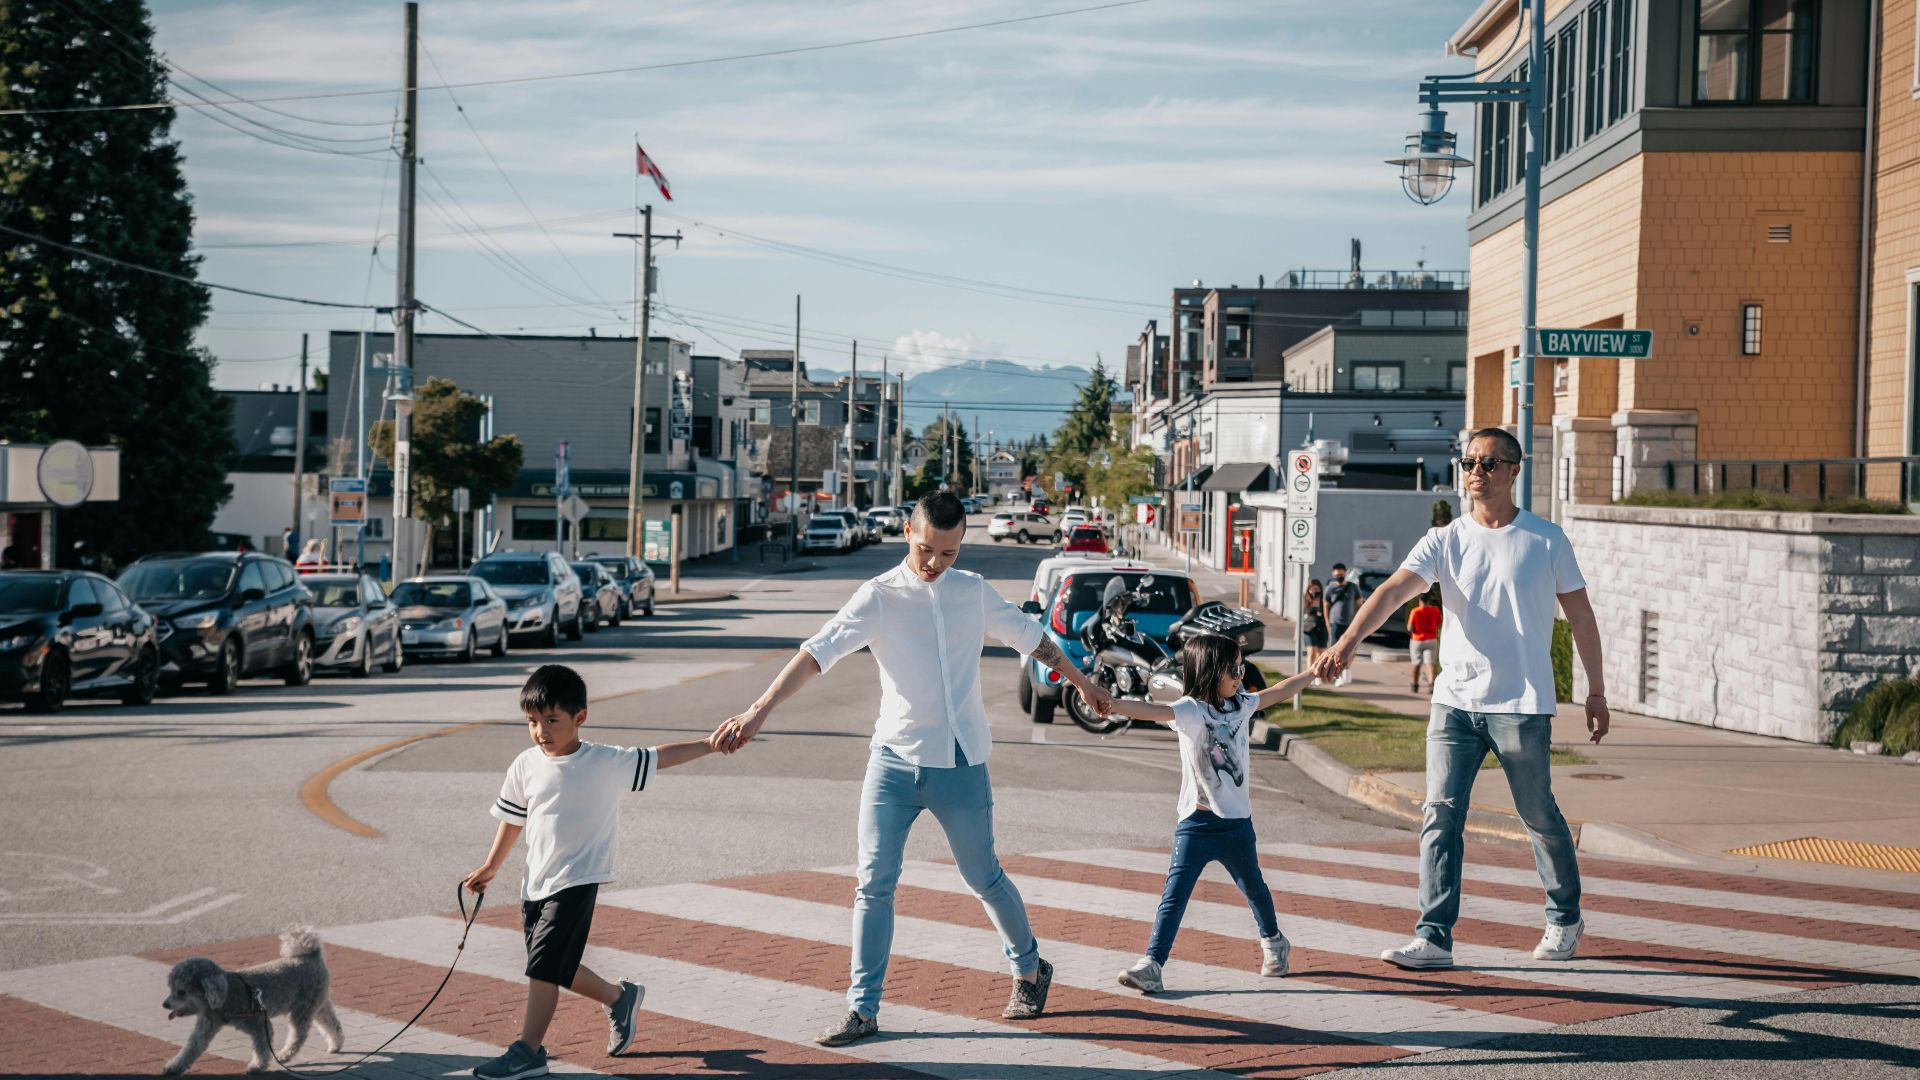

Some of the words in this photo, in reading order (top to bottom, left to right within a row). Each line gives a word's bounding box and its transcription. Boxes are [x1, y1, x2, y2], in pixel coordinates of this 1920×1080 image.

[1548, 333, 1627, 353] BAYVIEW
[1632, 334, 1641, 343] ST
[1297, 523, 1306, 534] P
